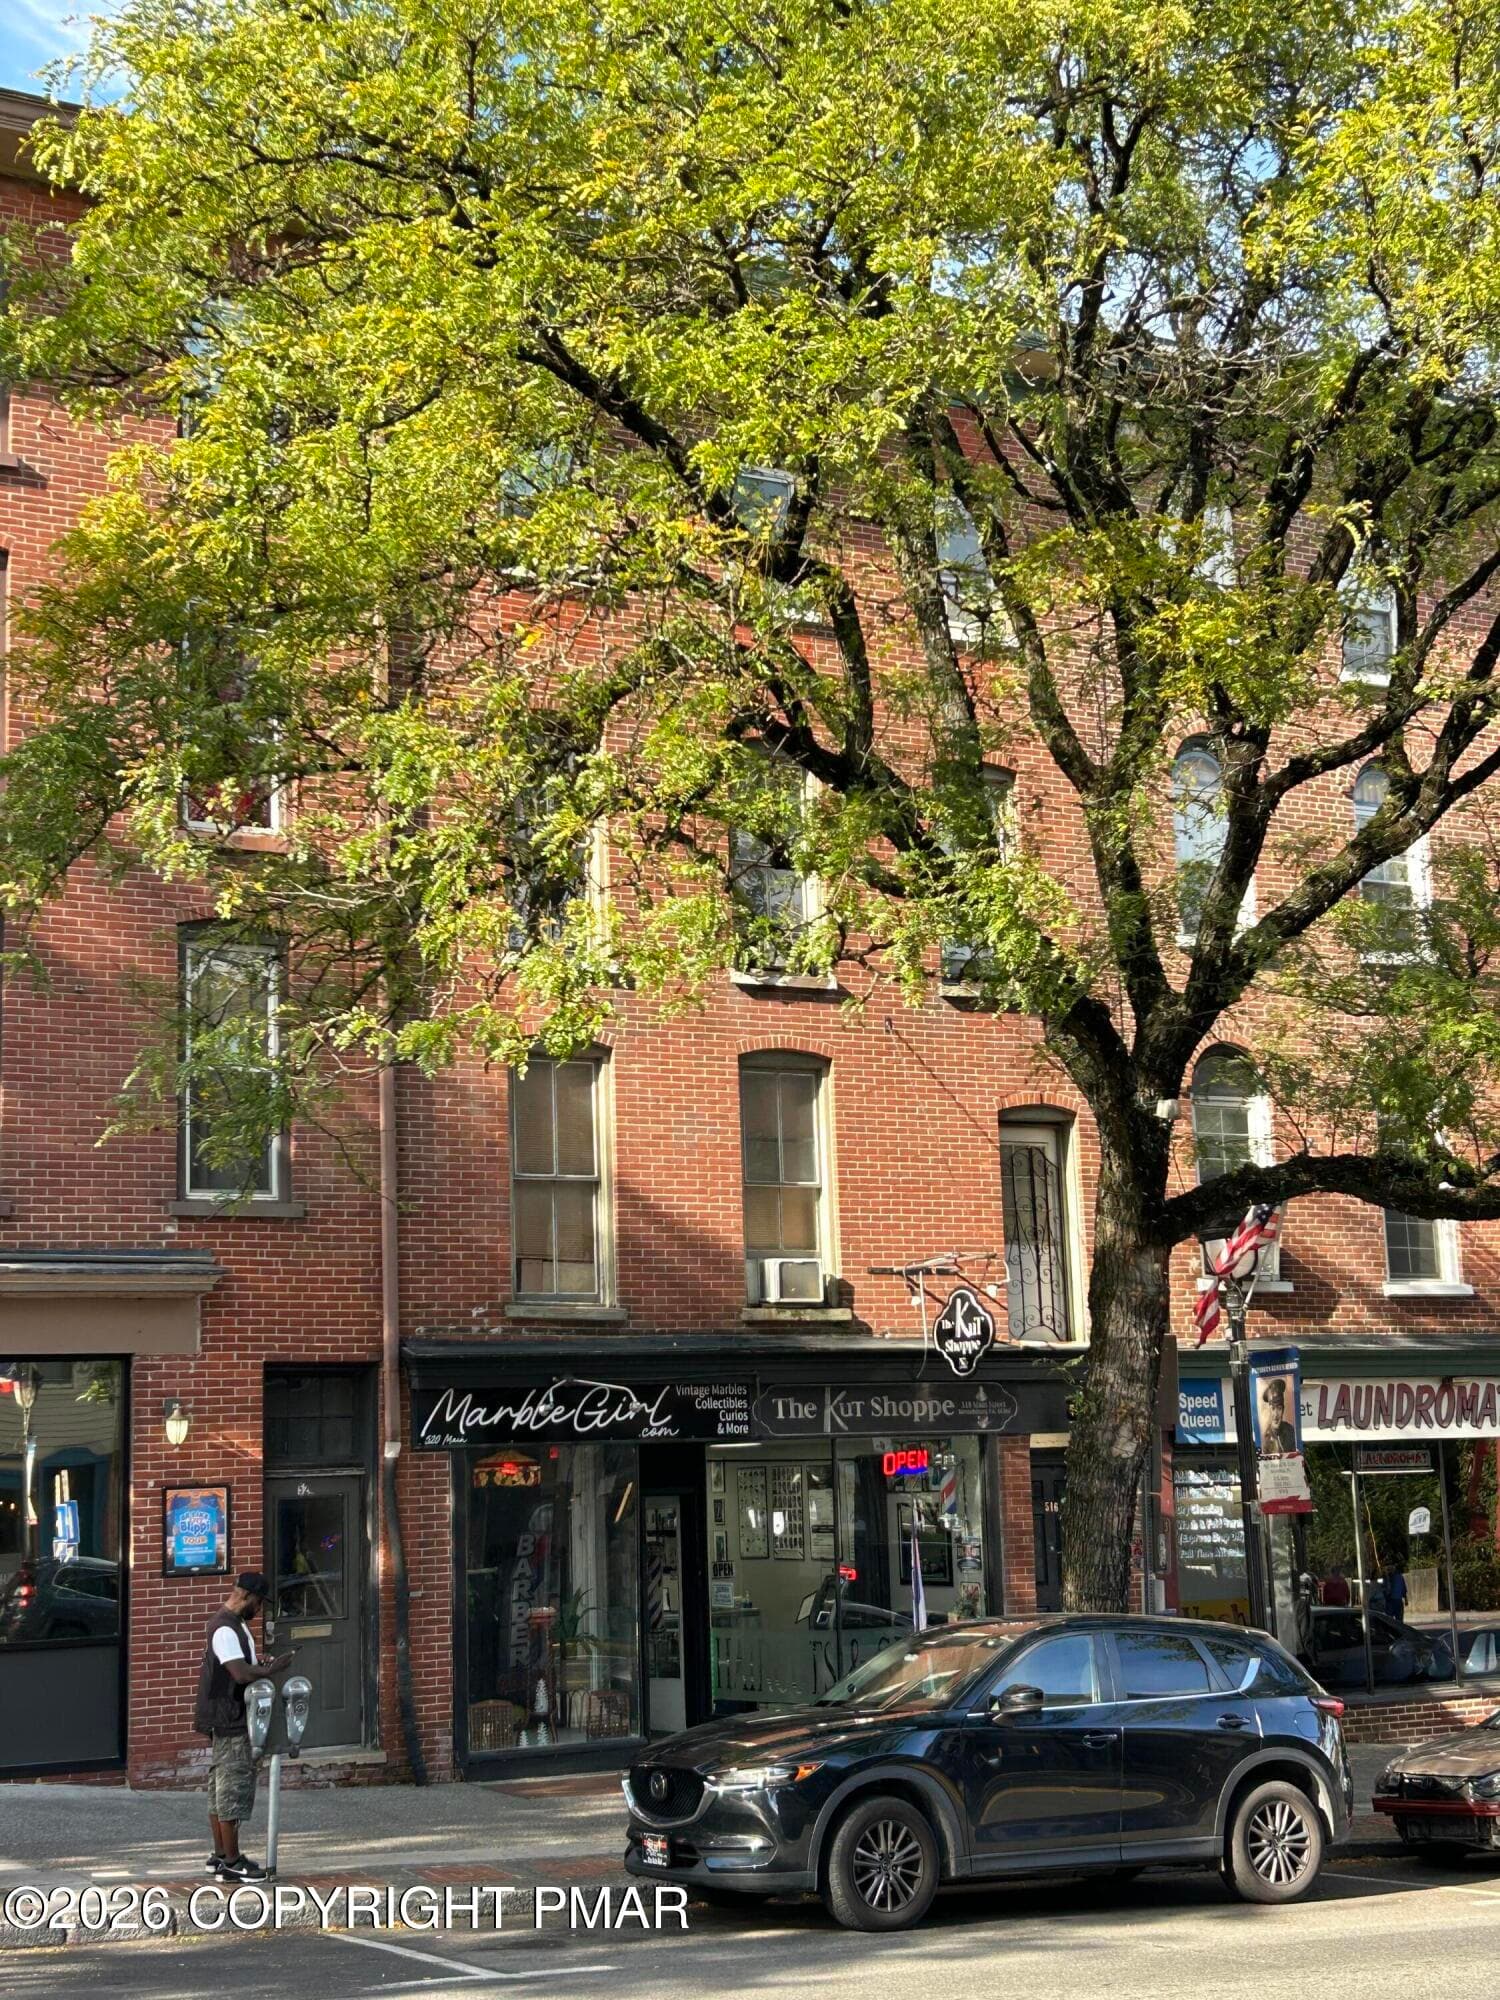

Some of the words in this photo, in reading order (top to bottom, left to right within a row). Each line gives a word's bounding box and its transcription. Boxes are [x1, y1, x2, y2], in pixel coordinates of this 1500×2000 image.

[675, 1384, 710, 1398] Vintage
[712, 1384, 747, 1395] Marbles
[695, 1397, 748, 1410] Collectibles
[772, 1398, 817, 1420] The
[871, 1396, 955, 1423] Shoppe
[1178, 1392, 1217, 1412] Speed
[1317, 1383, 1500, 1432] LAUNDROMA
[420, 1385, 672, 1437] MarbleGirl
[719, 1409, 749, 1421] Curios
[1179, 1412, 1220, 1429] Queen
[637, 1426, 680, 1438] .com
[717, 1423, 724, 1434] &
[726, 1423, 749, 1434] More
[883, 1448, 929, 1476] OPEN
[1044, 1501, 1059, 1513] 516
[180, 1520, 210, 1535] Blippi
[712, 1562, 734, 1577] OPEN
